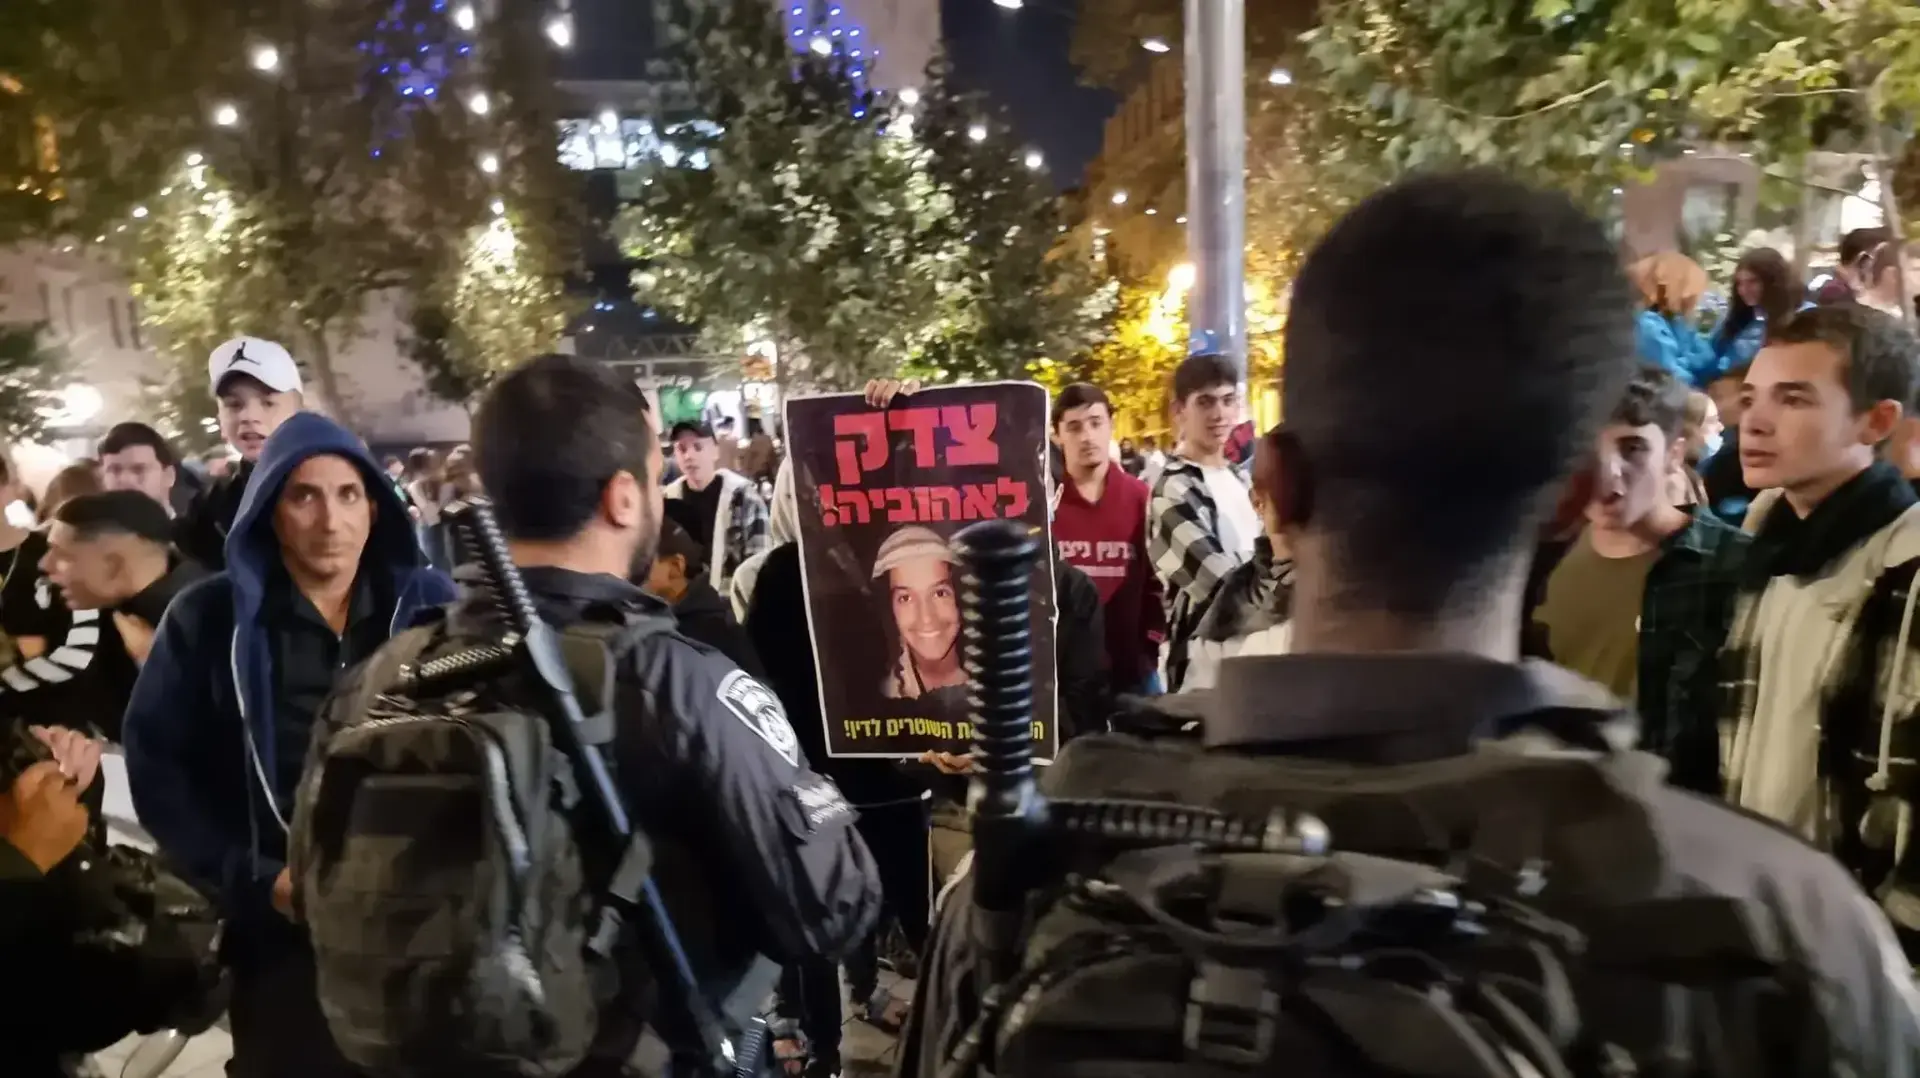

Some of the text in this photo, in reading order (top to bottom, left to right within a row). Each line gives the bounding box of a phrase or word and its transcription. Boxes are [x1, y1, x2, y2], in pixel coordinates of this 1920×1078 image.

[834, 403, 998, 485] צדק
[819, 477, 1029, 527] לאהוביה!
[843, 718, 881, 739] לדין!
[886, 718, 953, 739] השוטרים
